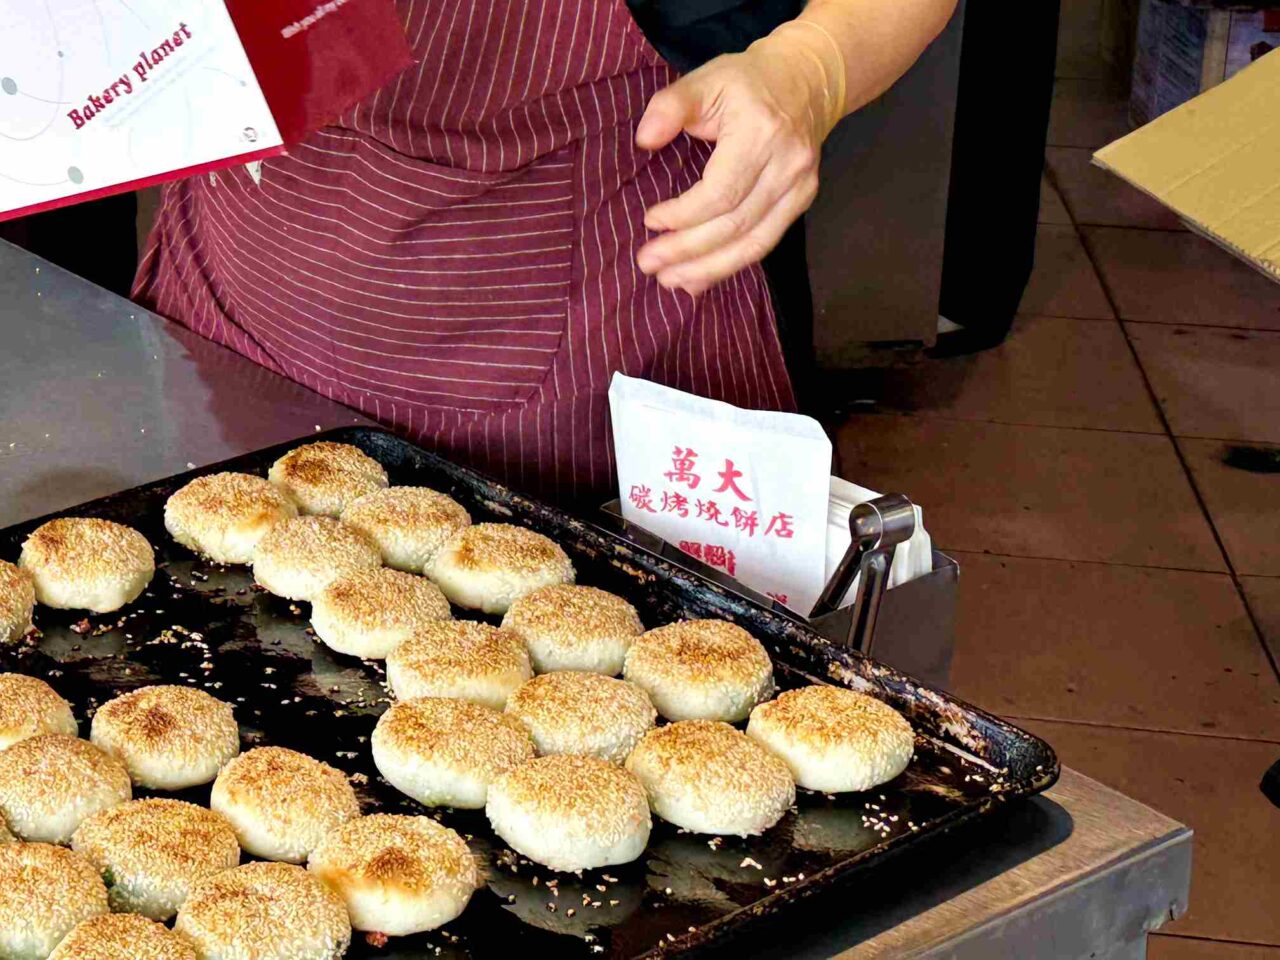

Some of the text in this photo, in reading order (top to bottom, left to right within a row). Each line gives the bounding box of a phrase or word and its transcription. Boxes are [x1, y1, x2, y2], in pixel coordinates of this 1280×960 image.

[67, 74, 133, 130] Bakery
[132, 22, 193, 82] planet
[664, 445, 753, 501] 萬大
[628, 484, 794, 538] 碳烤燒餅店
